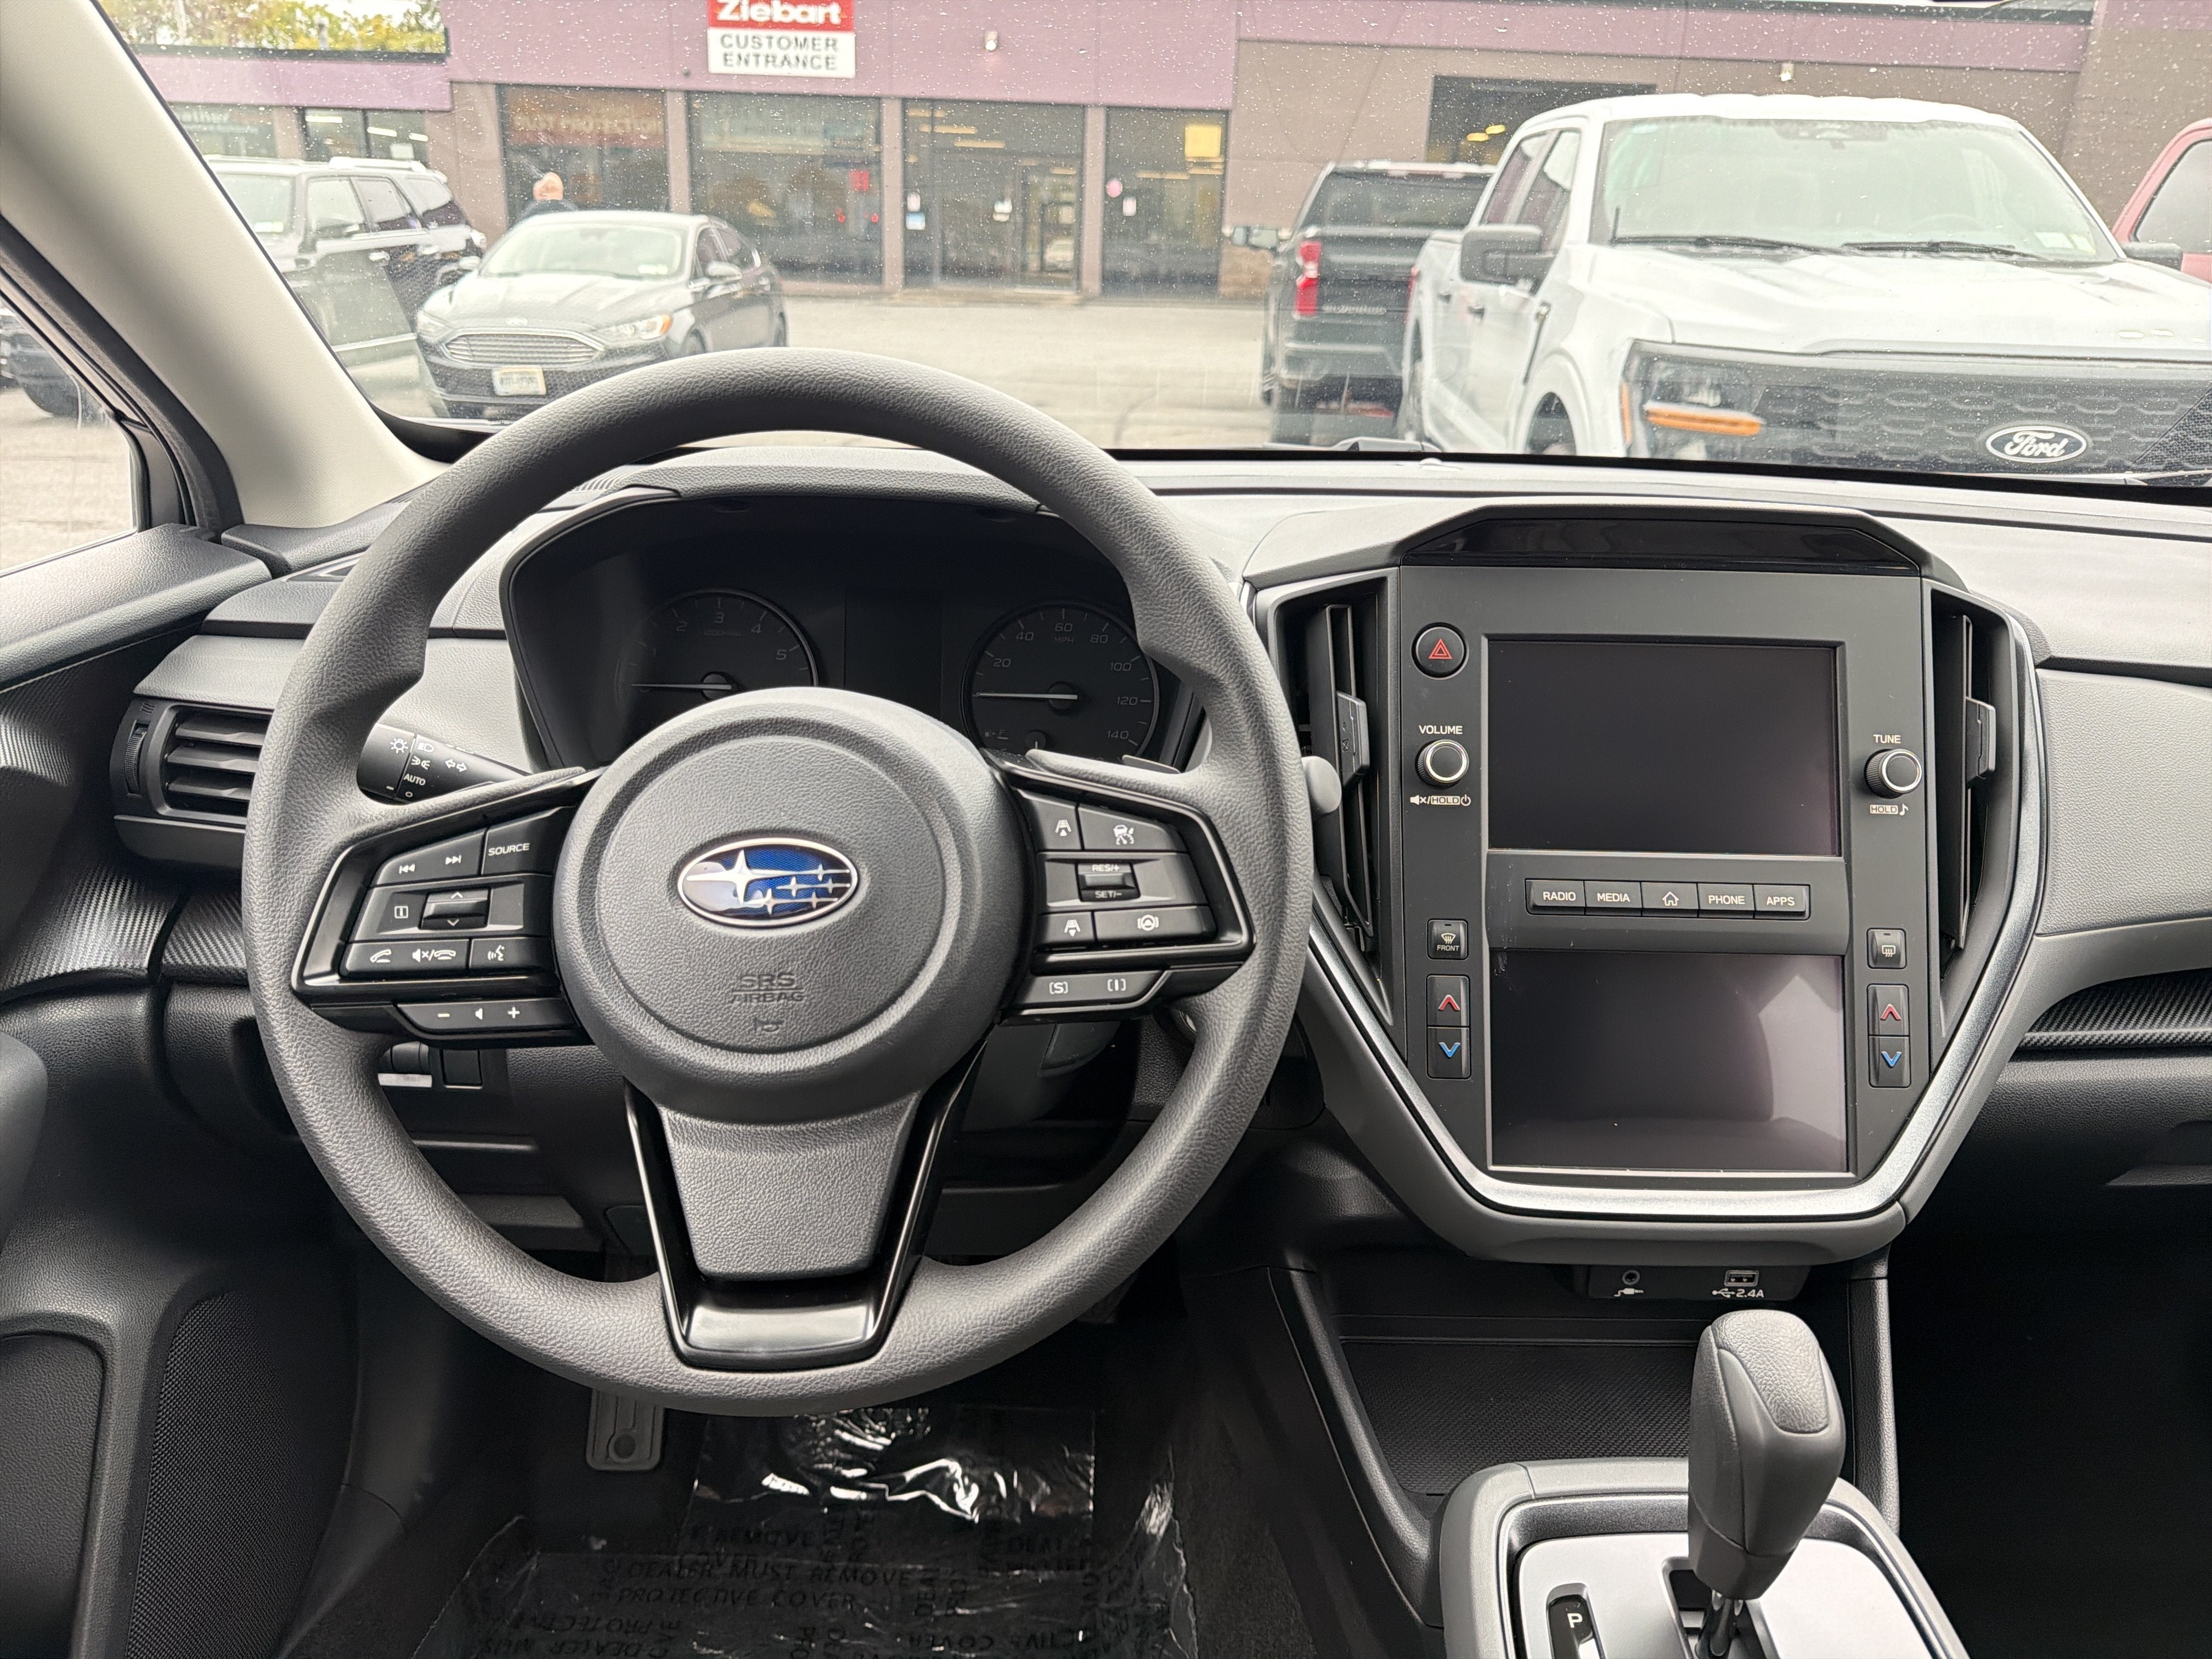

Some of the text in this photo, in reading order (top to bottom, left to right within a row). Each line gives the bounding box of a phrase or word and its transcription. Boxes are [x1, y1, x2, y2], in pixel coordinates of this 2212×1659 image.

[716, 0, 842, 25] Ziebart
[719, 33, 839, 52] CUSTOMER
[722, 52, 838, 71] ENTRANCE
[2004, 431, 2068, 458] Ford
[1054, 623, 1073, 632] 60
[1015, 631, 1034, 641] 40
[1090, 634, 1109, 644] 80
[993, 658, 1011, 668] 20
[1110, 662, 1132, 672] 100
[1116, 697, 1139, 706] 120
[1107, 730, 1130, 740] 140
[1418, 725, 1463, 735] VOLUME
[1872, 734, 1901, 744] TUNE
[403, 773, 426, 786] AUTO
[1431, 796, 1460, 805] HOLD
[1870, 805, 1898, 814] HOLD
[488, 842, 531, 857] SOURCE
[1542, 891, 1577, 902] RADIO
[1596, 893, 1631, 903] MEDIA
[1707, 894, 1746, 905] PHONE
[1765, 896, 1795, 906] APPS
[740, 972, 797, 989] SRS
[730, 992, 805, 1003] AIRBAG
[1735, 1289, 1765, 1299] 2.4A
[1567, 1612, 1583, 1628] P
